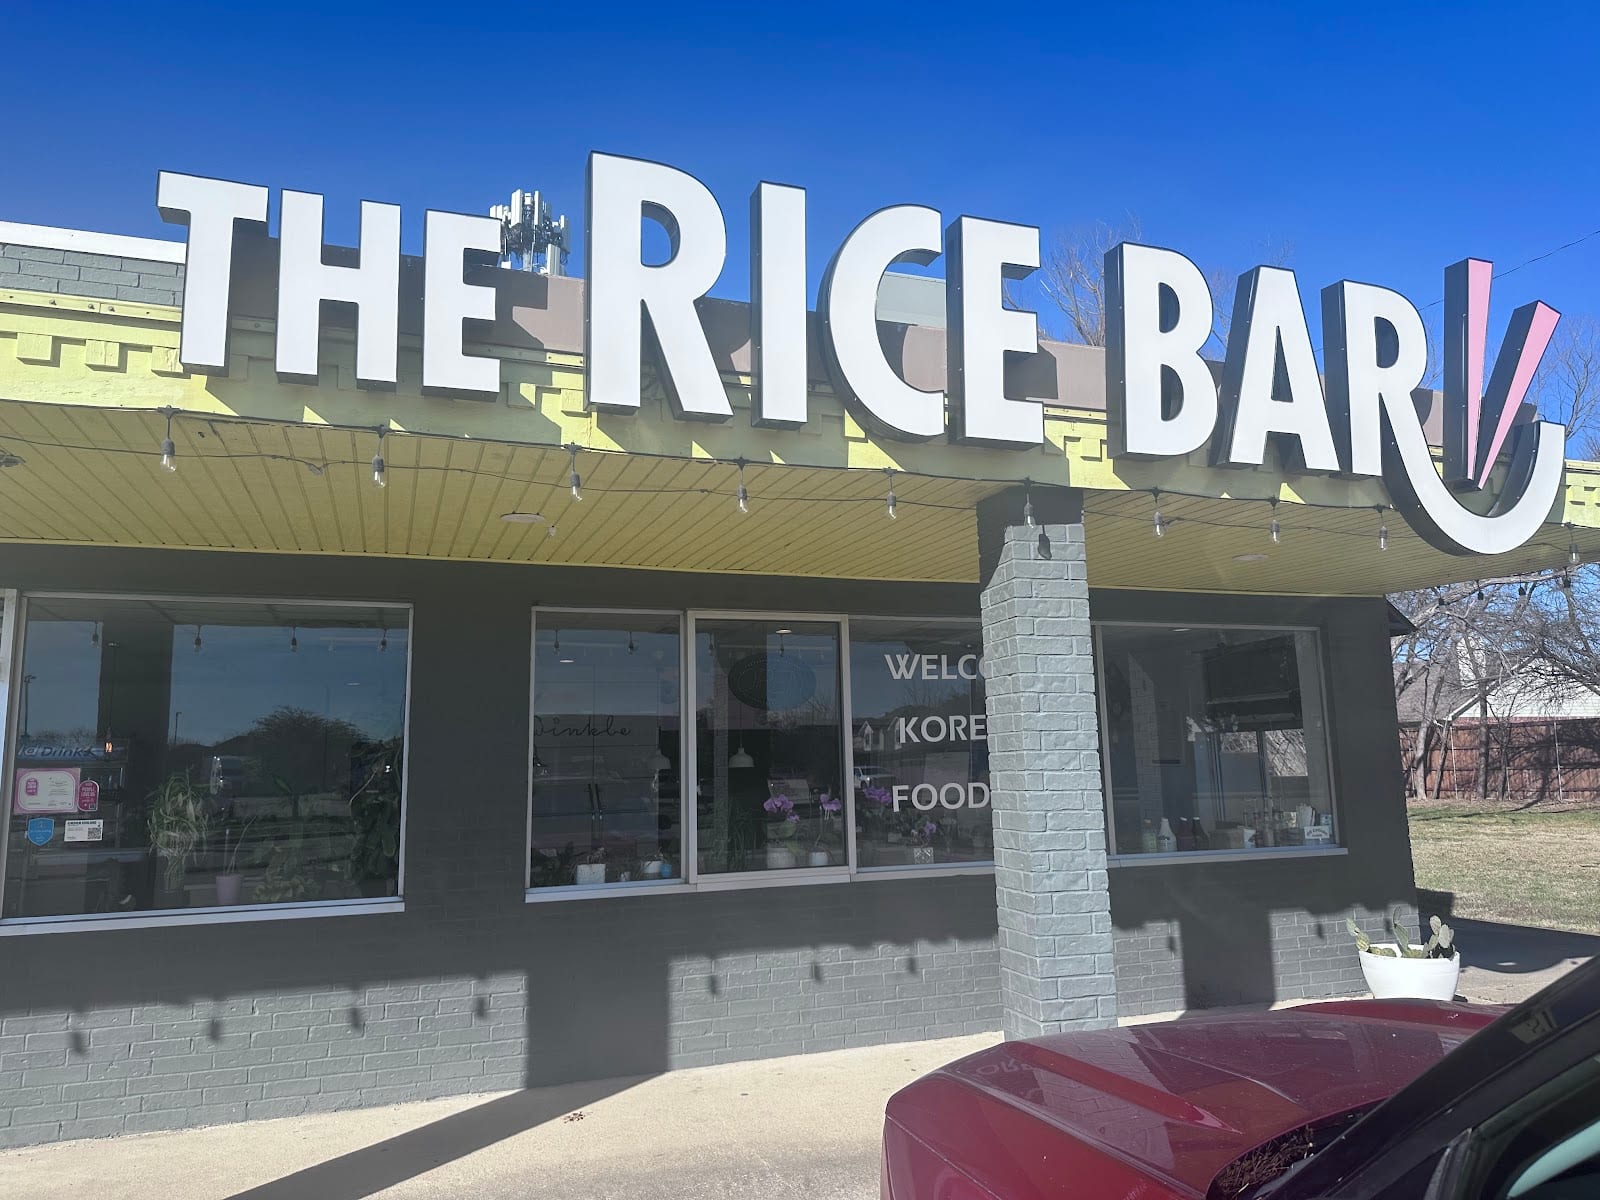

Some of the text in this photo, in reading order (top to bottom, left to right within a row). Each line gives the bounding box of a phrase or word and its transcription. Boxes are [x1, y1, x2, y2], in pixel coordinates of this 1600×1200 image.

[157, 151, 1564, 556] THE RICE BAR
[884, 652, 985, 681] WELC
[892, 782, 990, 813] FOOD
